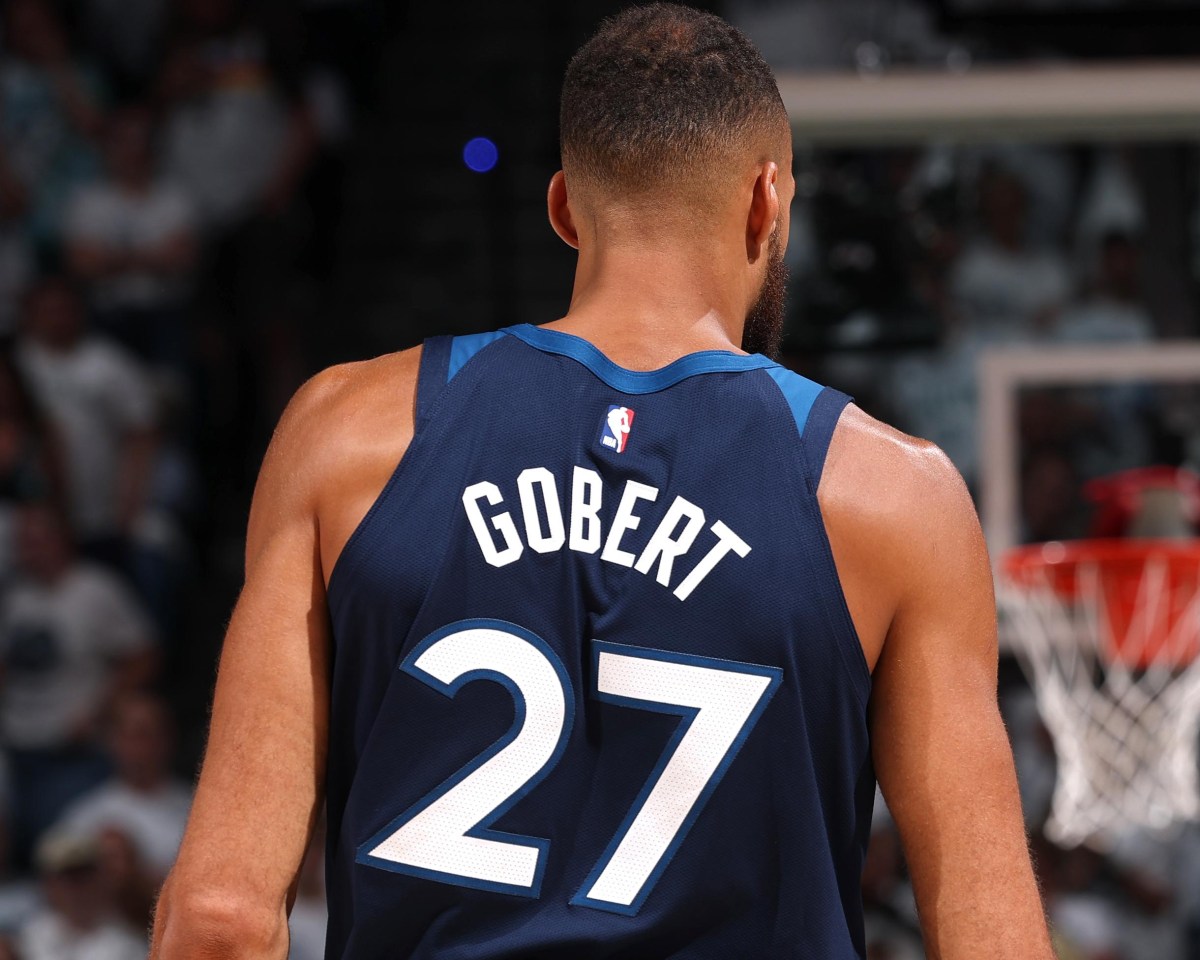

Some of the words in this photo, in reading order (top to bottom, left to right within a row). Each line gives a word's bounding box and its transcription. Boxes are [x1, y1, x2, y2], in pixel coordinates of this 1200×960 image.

[603, 435, 617, 448] NBA
[462, 465, 752, 601] GOBERT
[356, 618, 783, 917] 27
